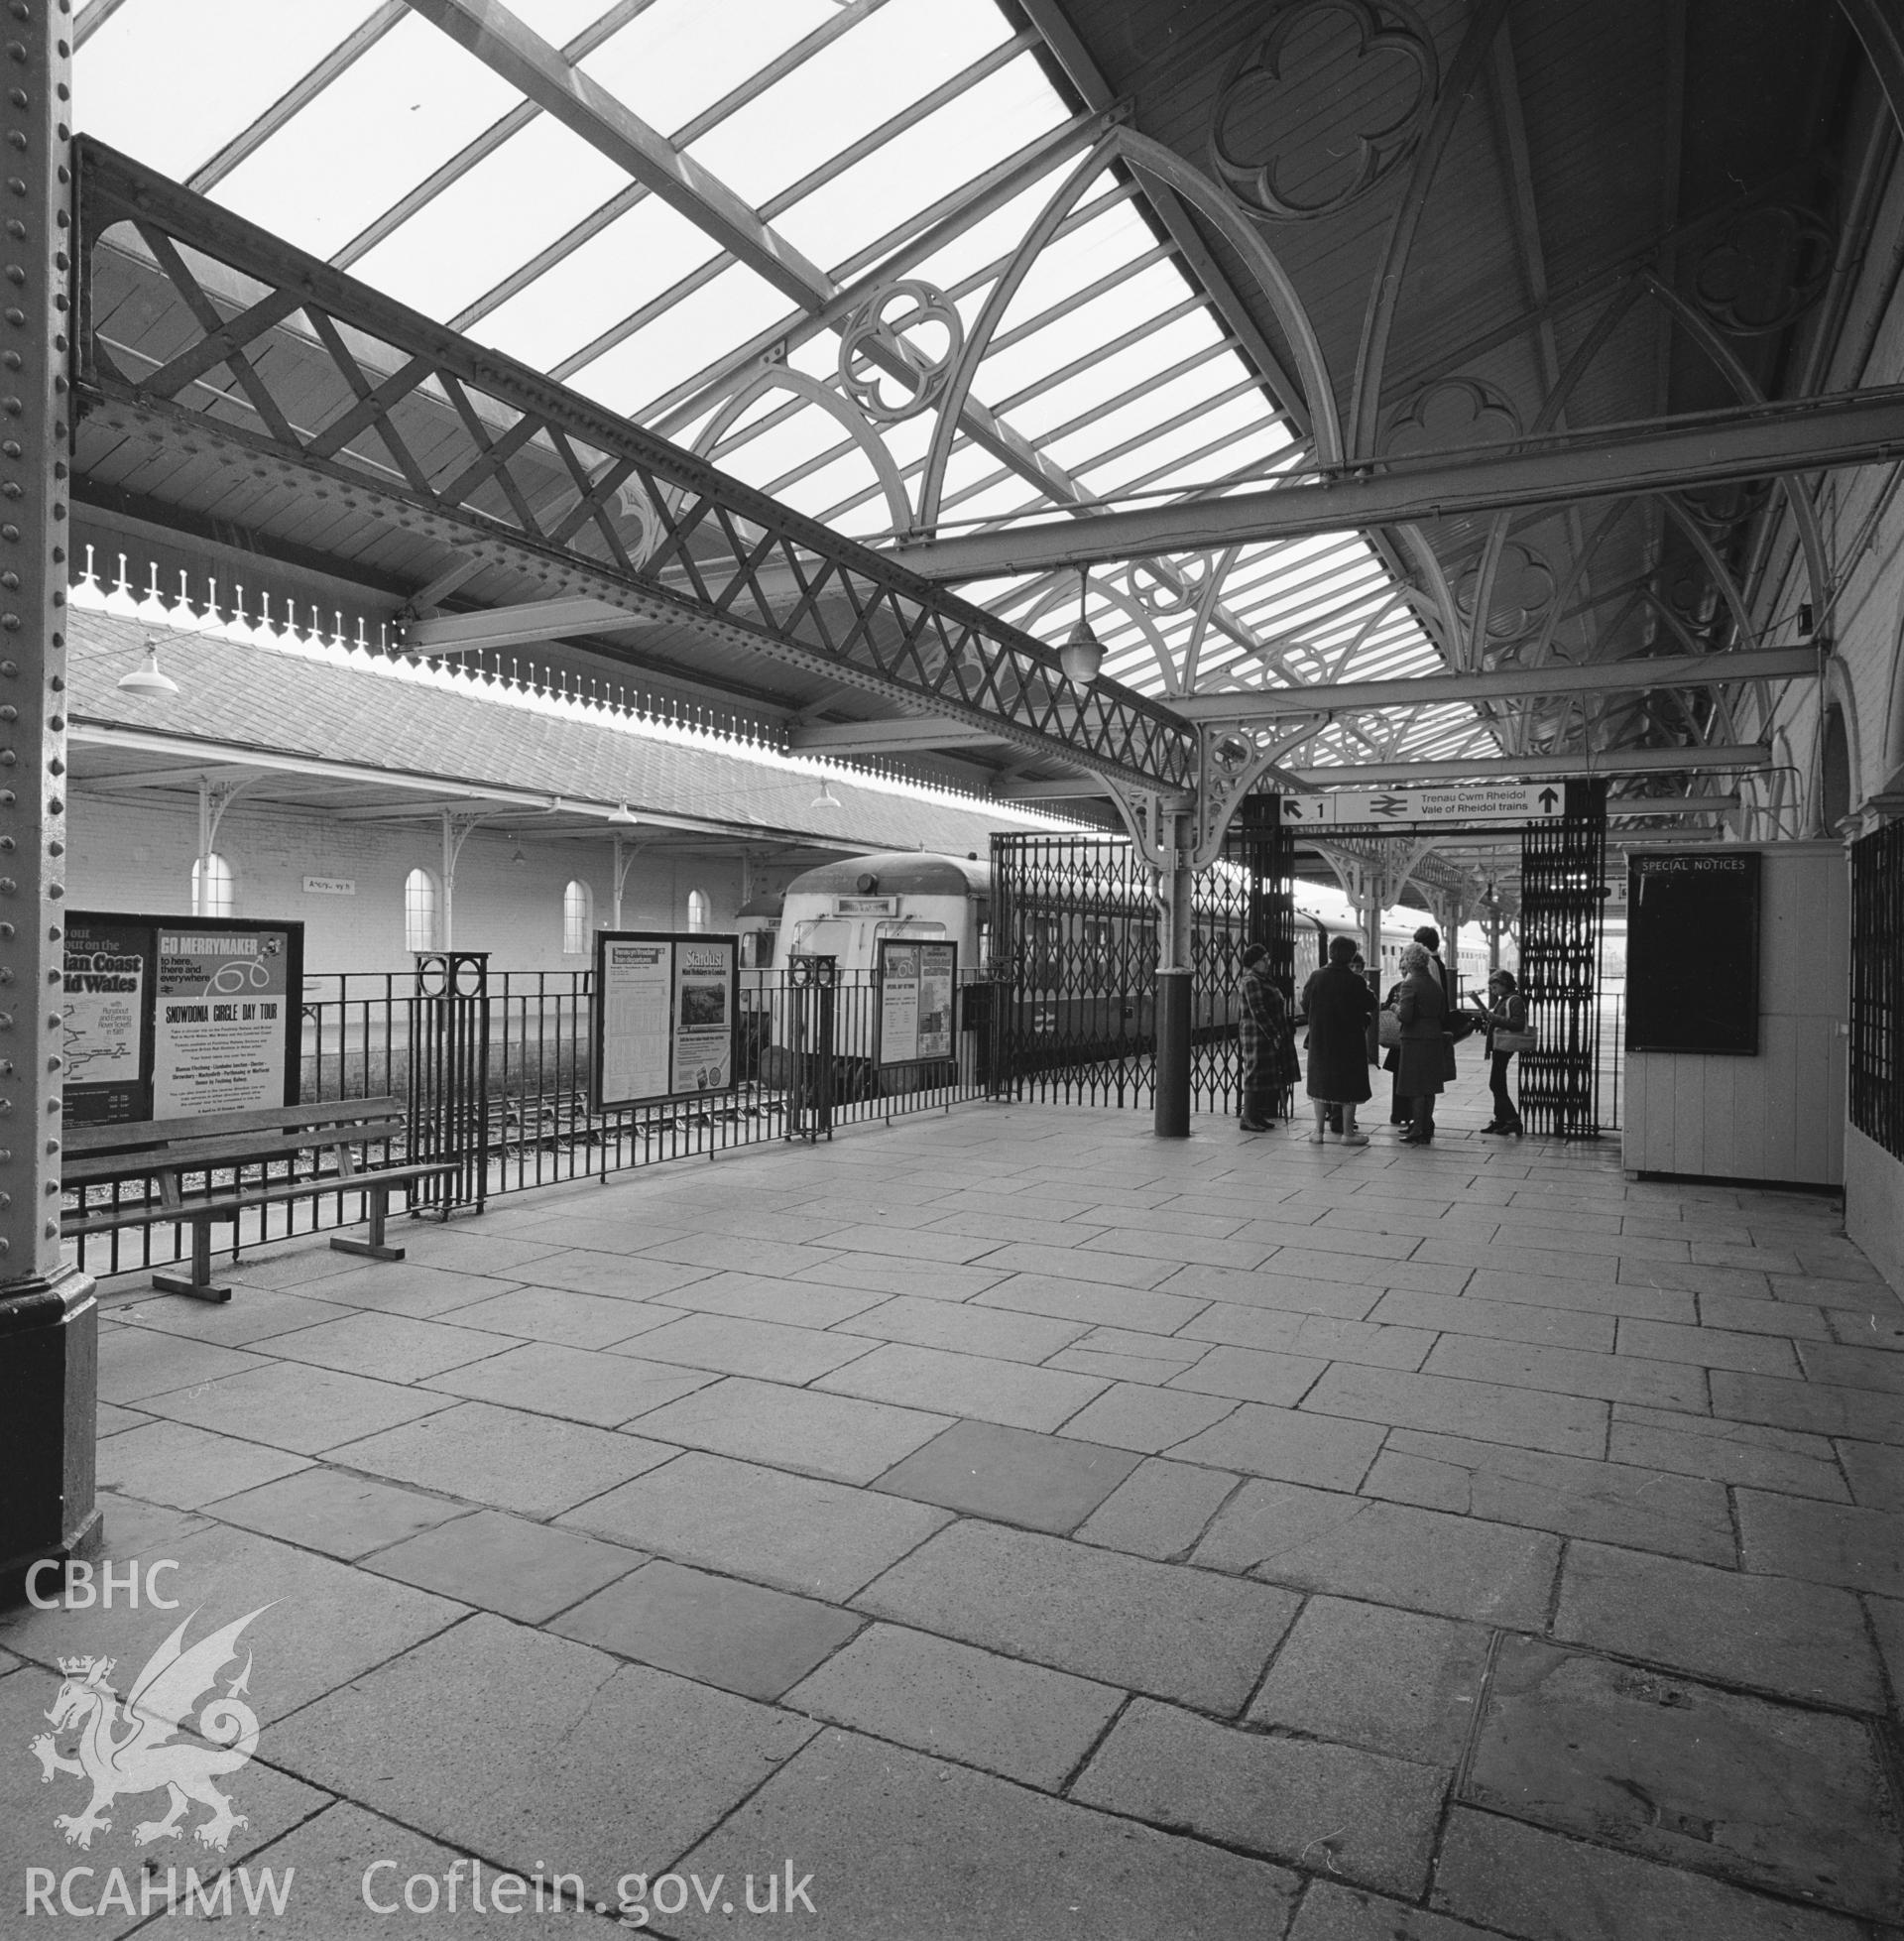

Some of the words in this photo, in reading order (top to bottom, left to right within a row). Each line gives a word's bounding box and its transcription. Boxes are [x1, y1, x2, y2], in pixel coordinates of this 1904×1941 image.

[1421, 793, 1456, 802] Trenau
[1458, 792, 1485, 801] Cwm
[1487, 790, 1526, 800] Rheidol
[1317, 803, 1324, 818] 1
[1421, 805, 1442, 814] Vale
[1445, 804, 1455, 813] of
[1457, 802, 1496, 813] Rheidol
[1498, 801, 1528, 811] trains
[1642, 861, 1689, 872] SPECIAL
[1694, 860, 1745, 871] NOTICES
[101, 939, 120, 950] the
[161, 936, 178, 955] GO
[179, 936, 258, 955] MERRYMAKER
[92, 952, 142, 973] Coast
[161, 957, 170, 966] to
[171, 957, 192, 967] here,
[686, 949, 724, 967] Stardust
[82, 973, 138, 994] Wales
[160, 974, 211, 984] everywhere
[166, 1005, 209, 1024] SNOWDONIA
[213, 1004, 238, 1022] CIRCLE
[242, 1004, 256, 1021] DAY
[260, 1003, 278, 1020] TOUR
